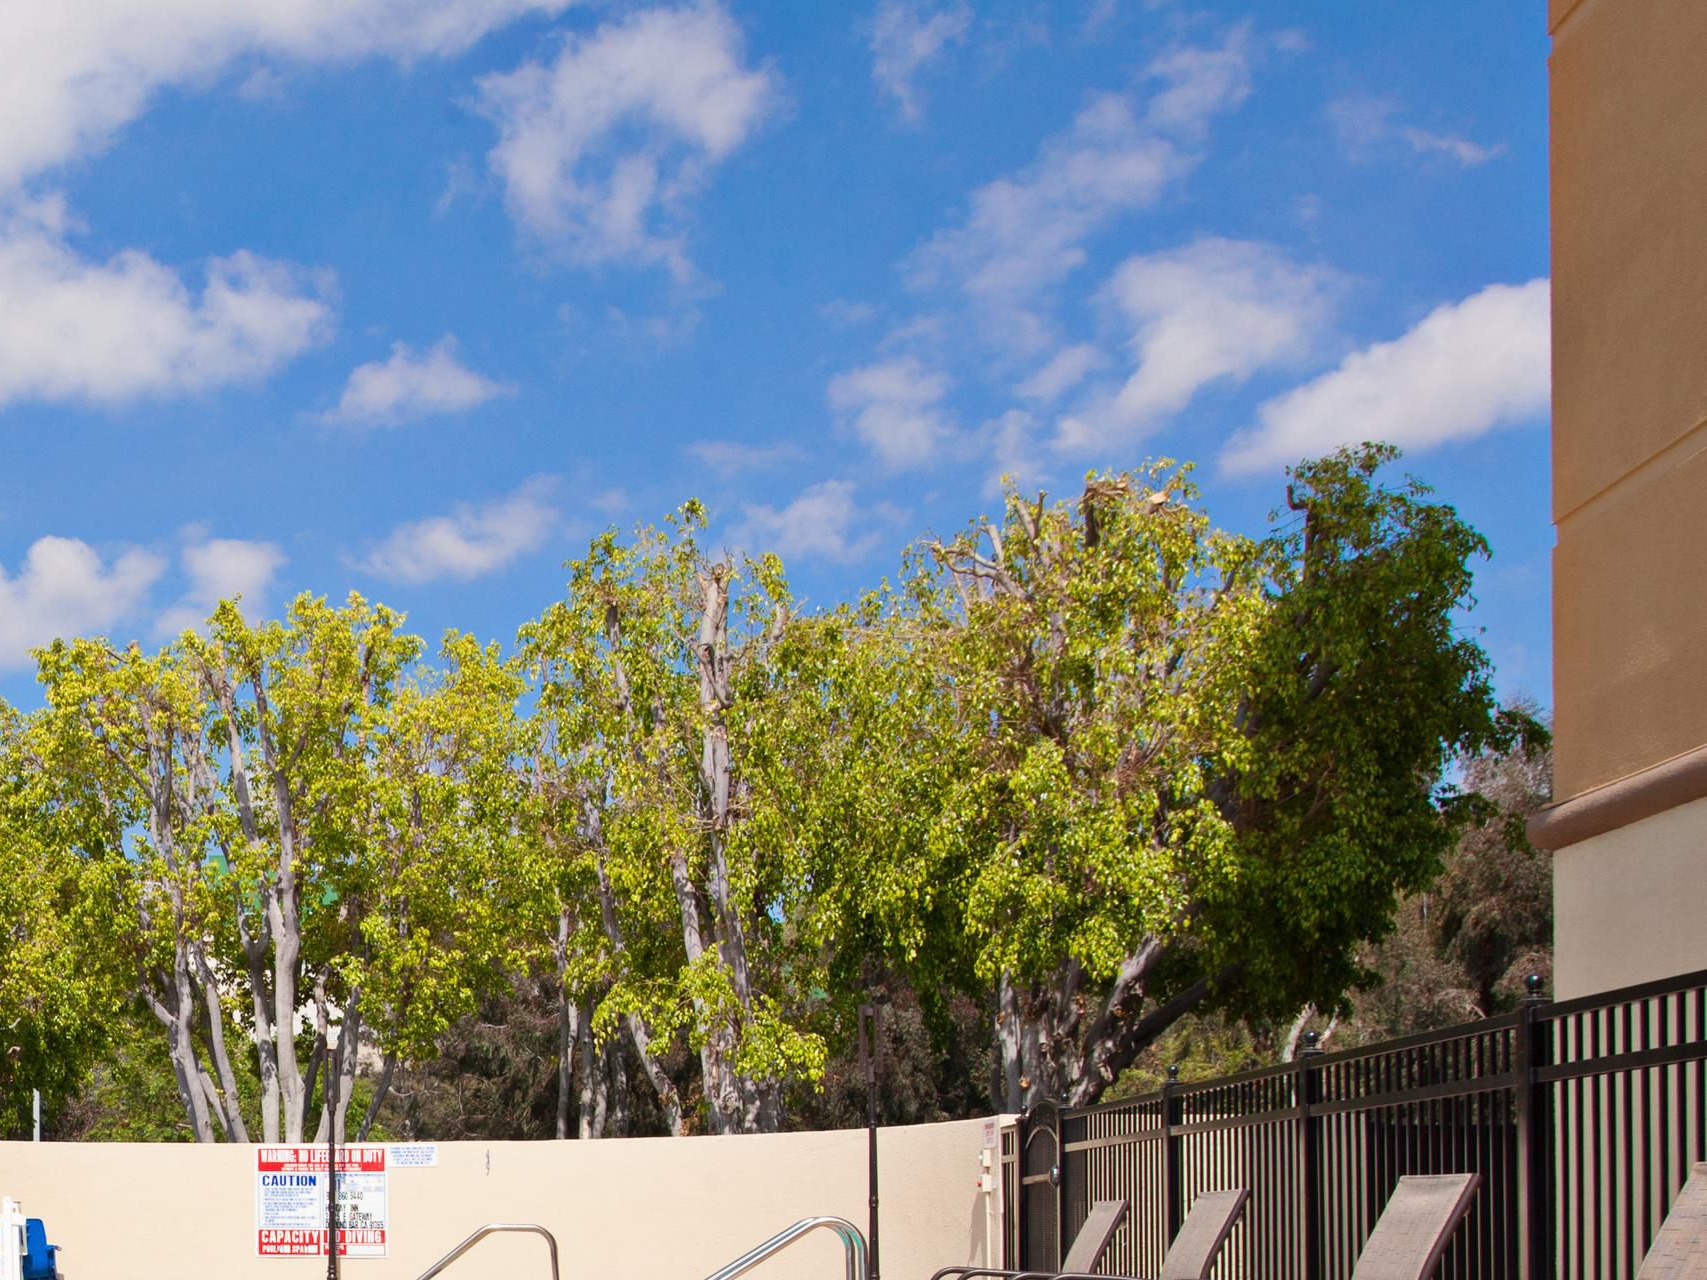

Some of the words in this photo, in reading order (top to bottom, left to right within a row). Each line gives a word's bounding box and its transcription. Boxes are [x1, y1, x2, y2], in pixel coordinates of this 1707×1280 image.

[299, 1149, 308, 1162] NO
[351, 1149, 361, 1162] ON
[363, 1149, 382, 1162] DUTY
[262, 1175, 316, 1186] CAUTION
[261, 1230, 318, 1243] CAPACITY
[346, 1231, 381, 1243] DIVING
